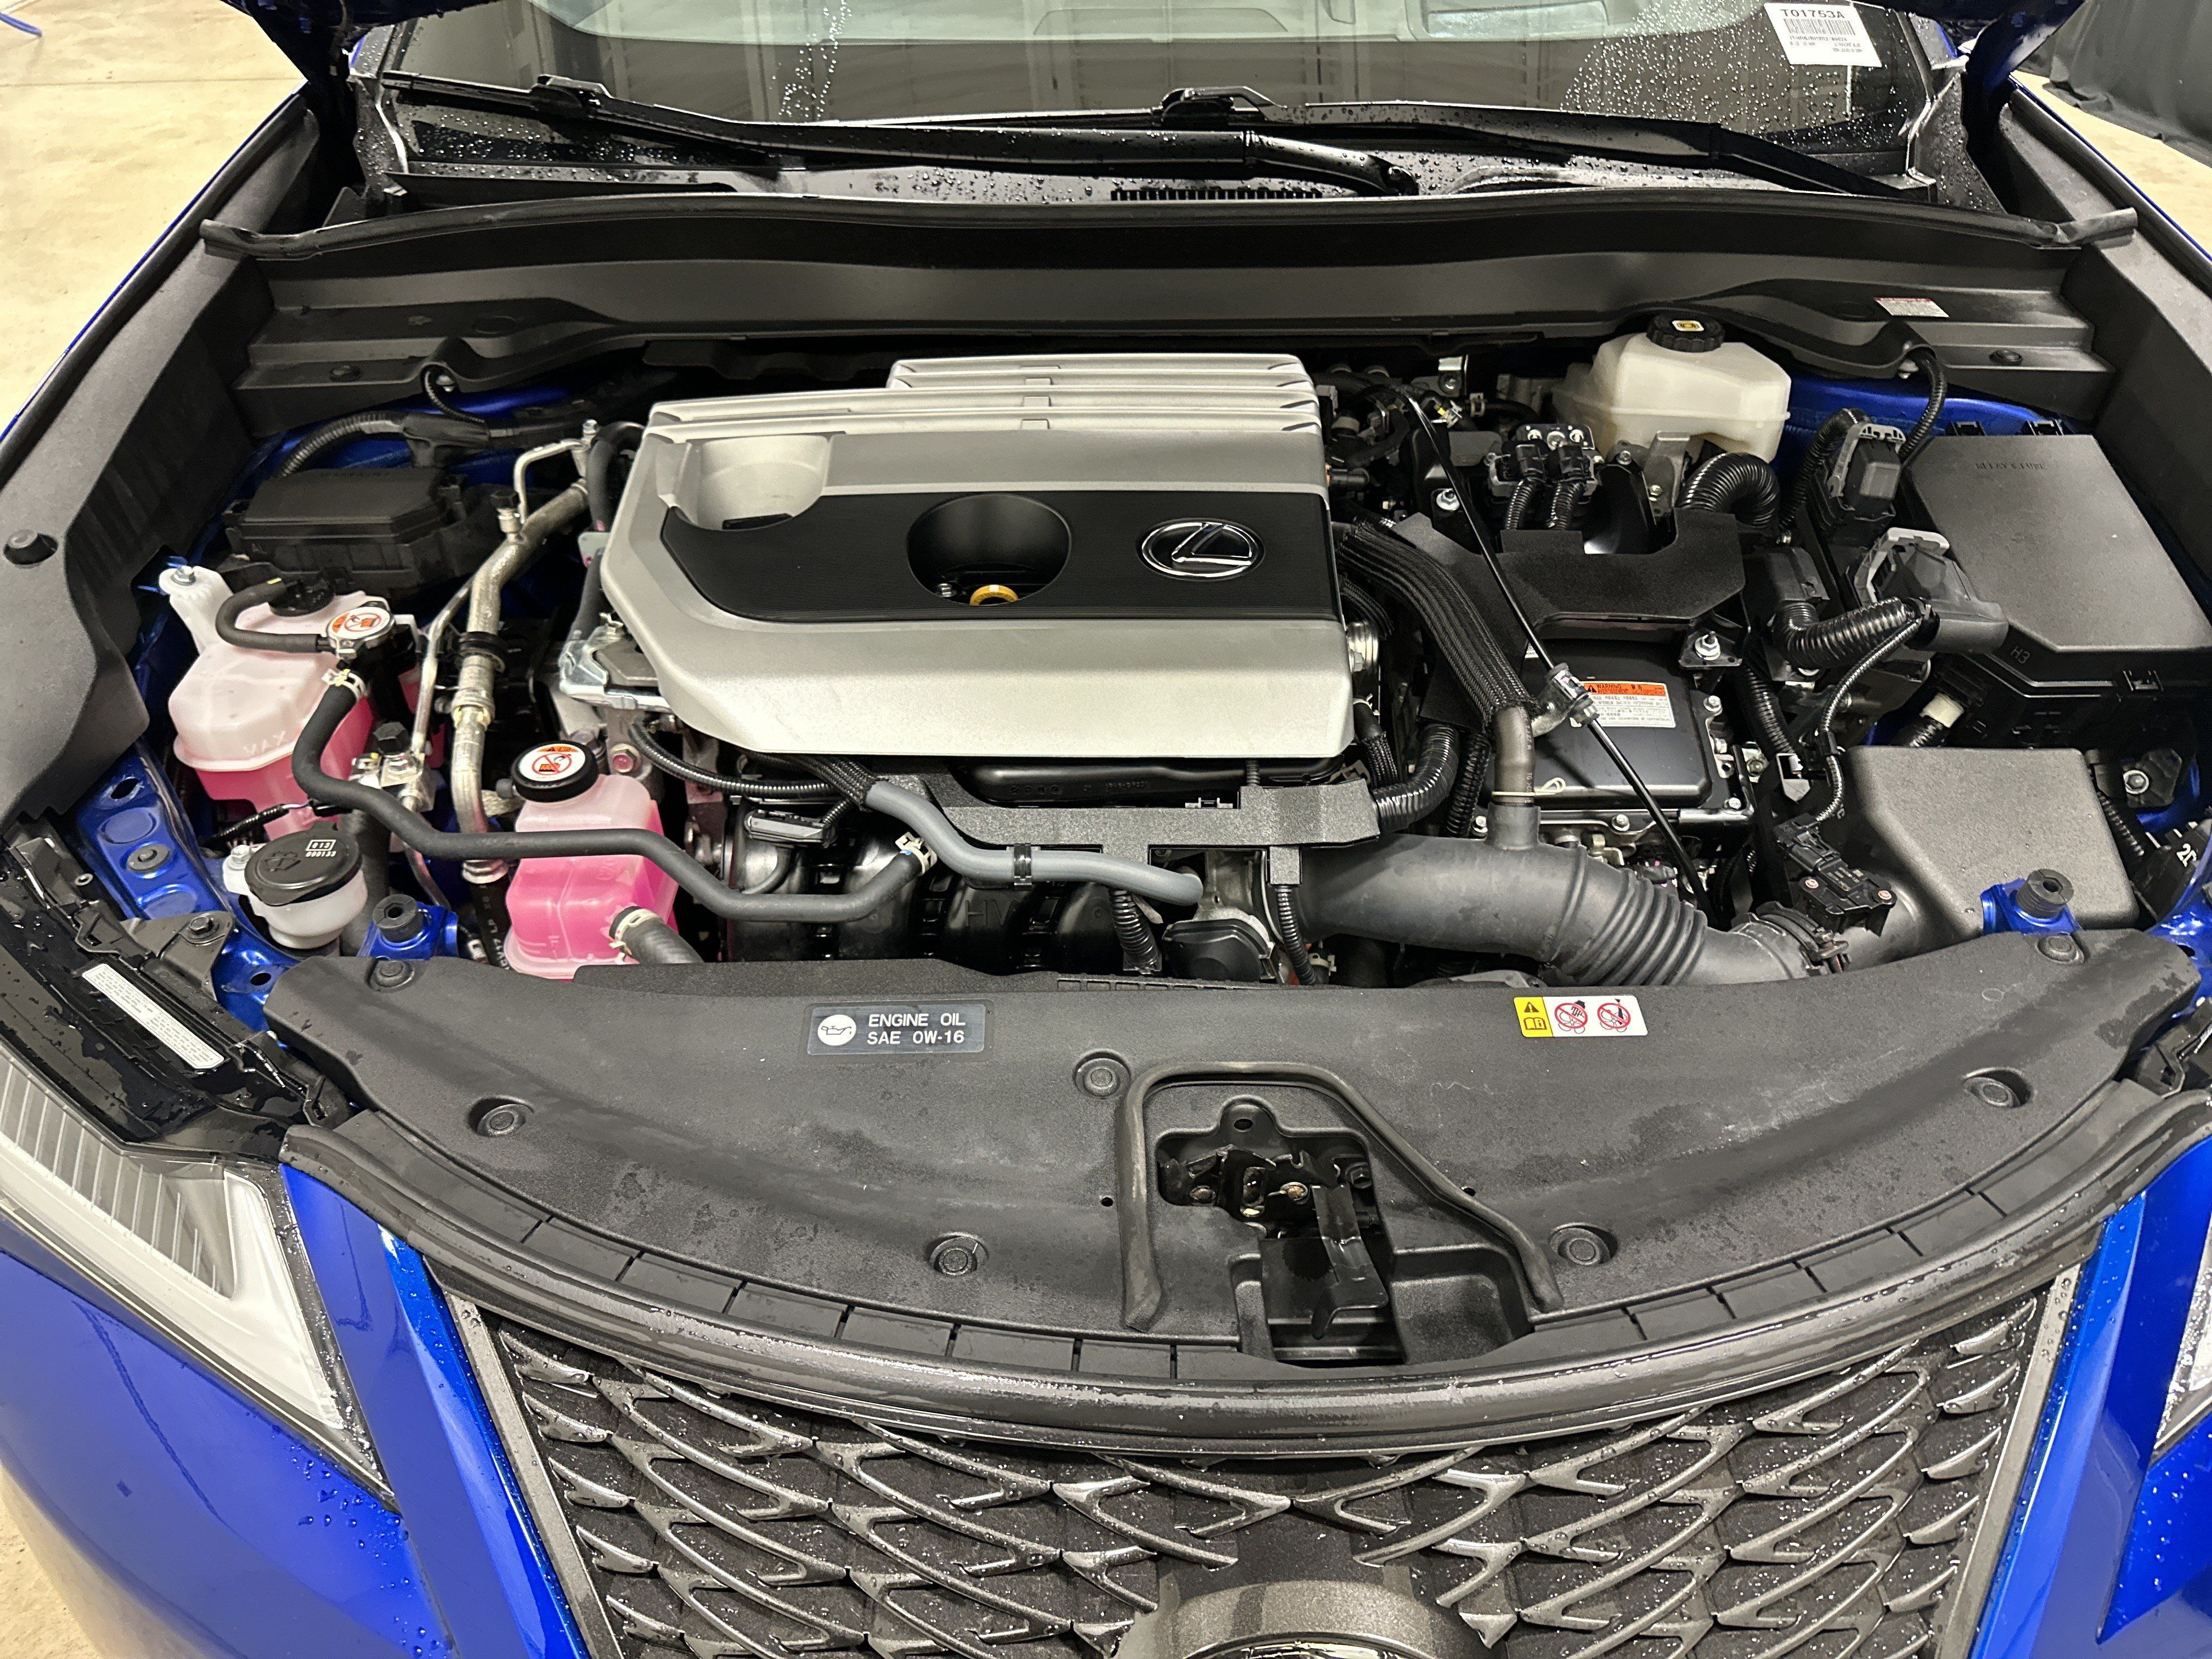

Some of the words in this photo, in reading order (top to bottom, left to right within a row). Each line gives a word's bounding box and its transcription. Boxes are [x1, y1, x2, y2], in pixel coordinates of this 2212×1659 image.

[1780, 9, 1845, 19] T01753A
[868, 1013, 929, 1028] ENGINE
[940, 1012, 966, 1026] OIL
[866, 1030, 901, 1045] SAE
